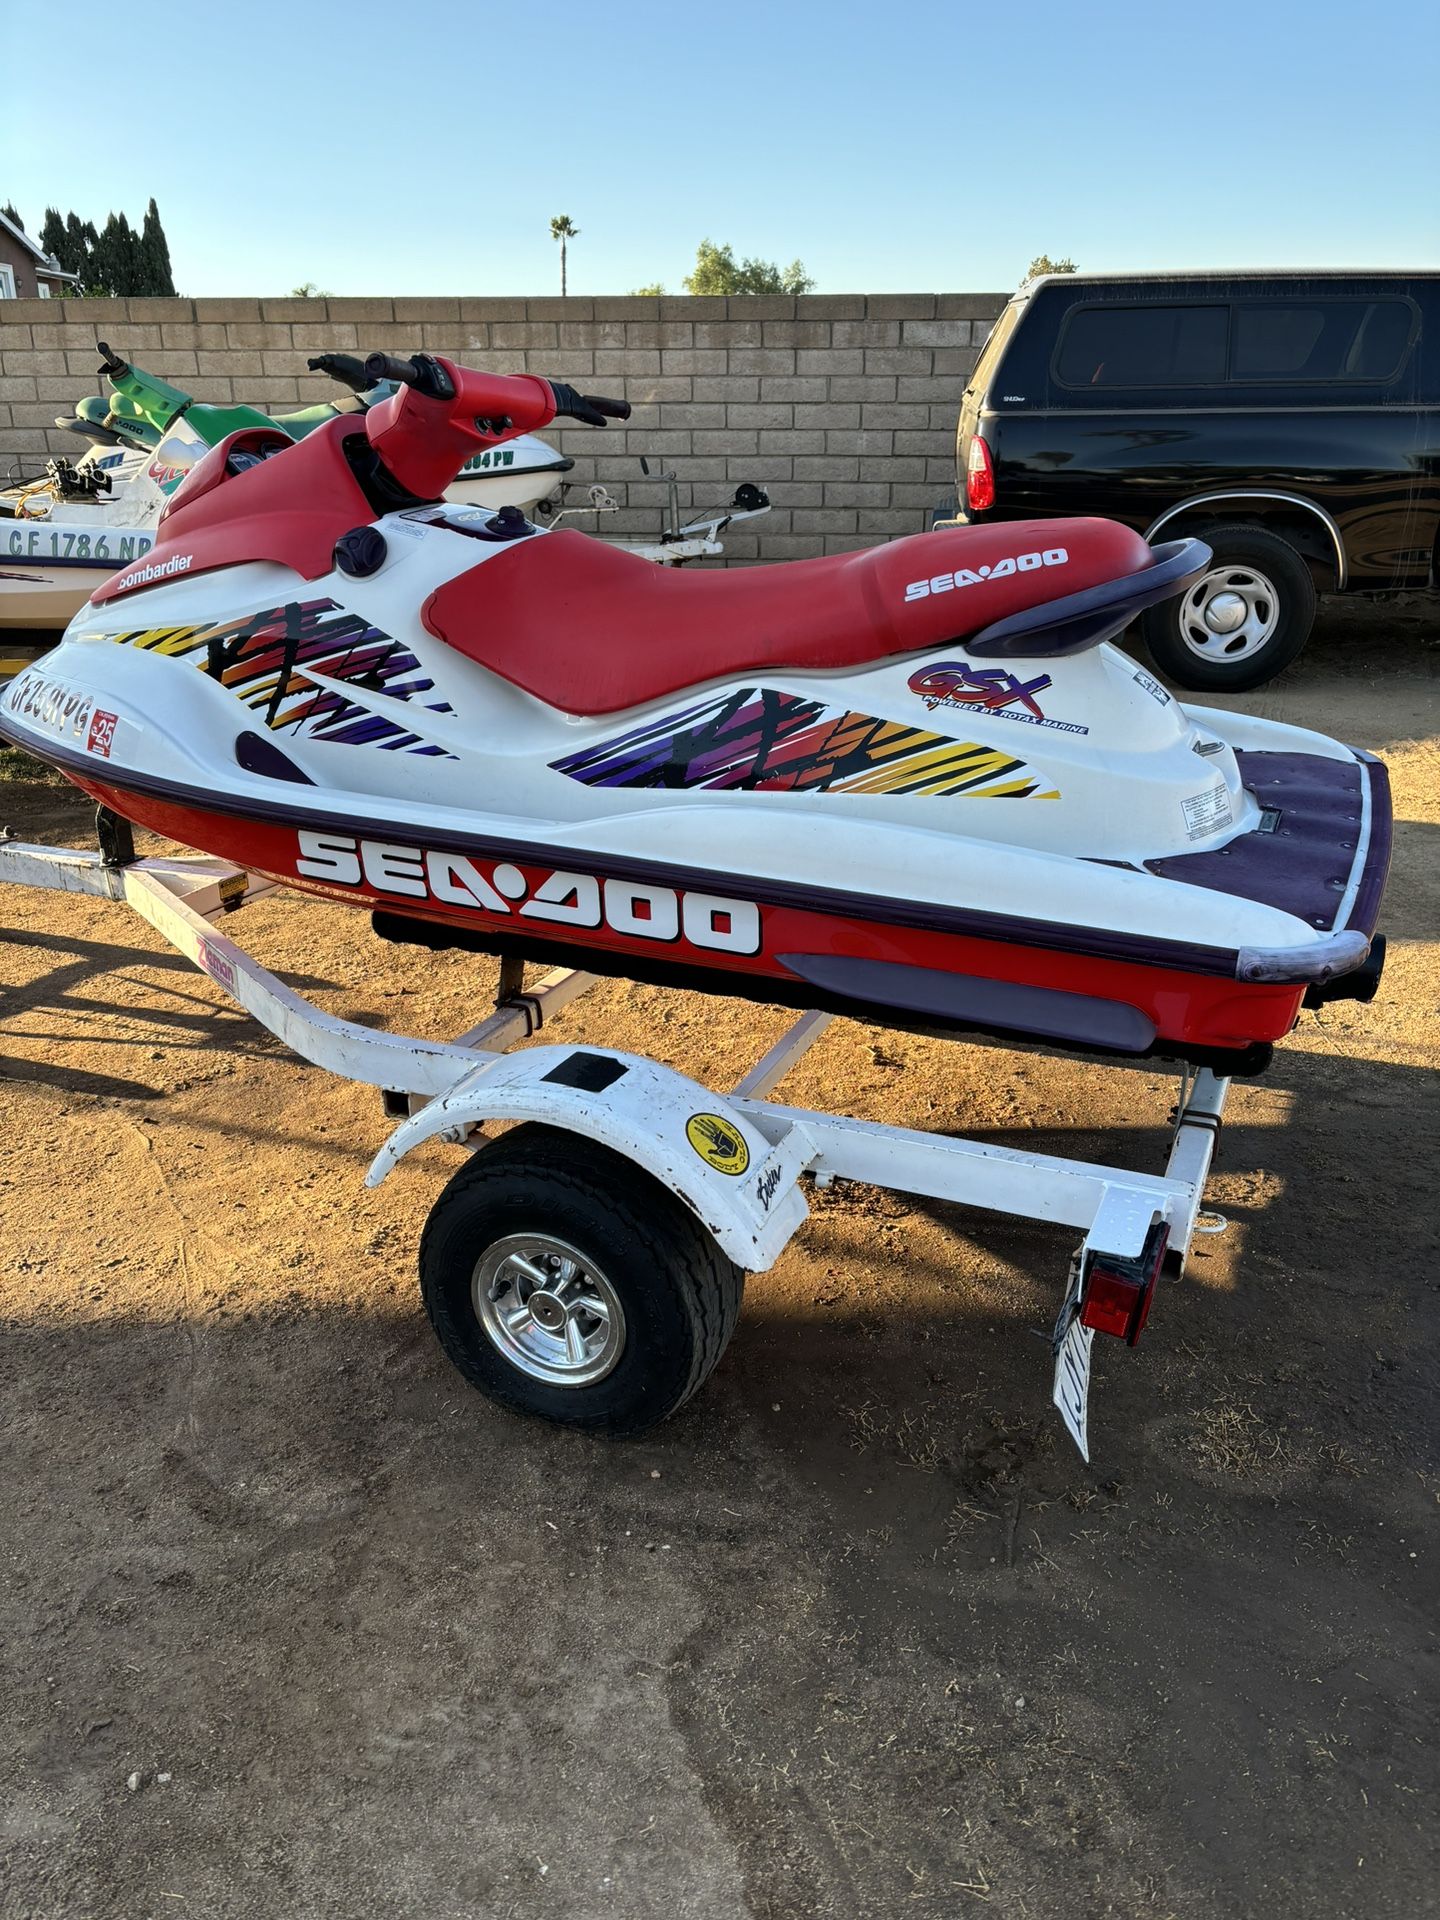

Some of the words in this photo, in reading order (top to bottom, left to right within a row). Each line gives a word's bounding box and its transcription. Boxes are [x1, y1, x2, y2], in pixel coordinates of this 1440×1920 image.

[493, 450, 515, 468] PW
[9, 530, 40, 556] CF
[50, 532, 110, 560] 1786
[119, 536, 152, 561] NP
[907, 661, 1053, 720] GSX
[922, 695, 979, 712] POWERED
[980, 706, 999, 717] BY
[1000, 710, 1039, 725] ROTAX
[1040, 718, 1088, 736] MARINE
